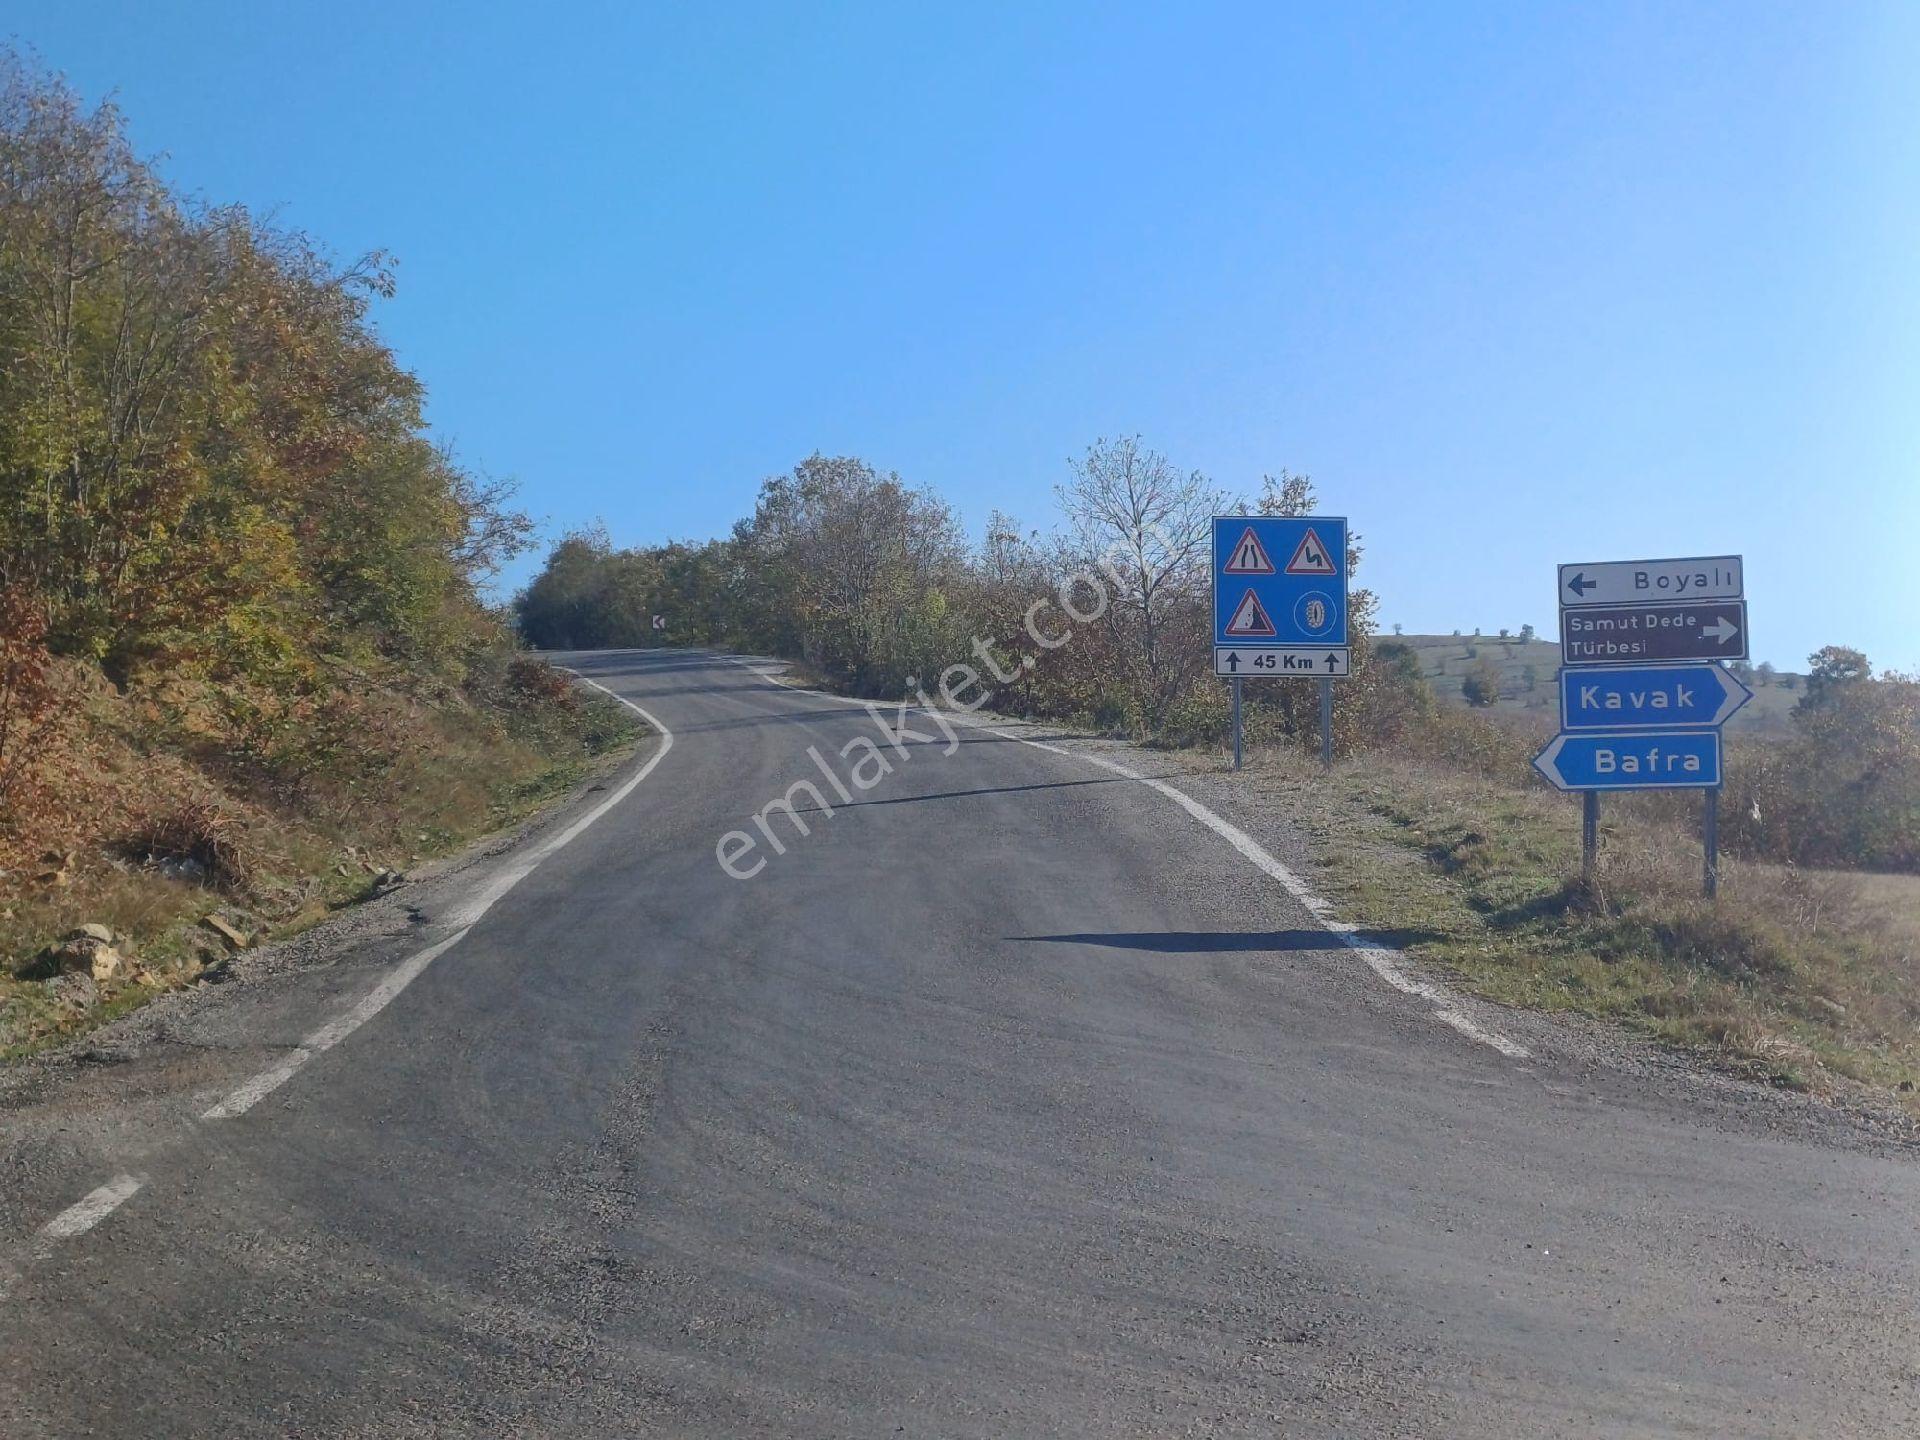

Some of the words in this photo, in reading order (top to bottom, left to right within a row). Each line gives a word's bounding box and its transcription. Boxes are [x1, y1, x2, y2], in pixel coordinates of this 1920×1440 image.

[1634, 568, 1733, 592] Boyalı
[1571, 617, 1638, 632] Samut
[1646, 613, 1697, 629] Dede
[1571, 640, 1647, 655] Türbesi
[1254, 655, 1276, 669] 45
[1283, 655, 1313, 669] Km
[1580, 684, 1695, 709] Kavak
[1595, 748, 1701, 773] Bafra
